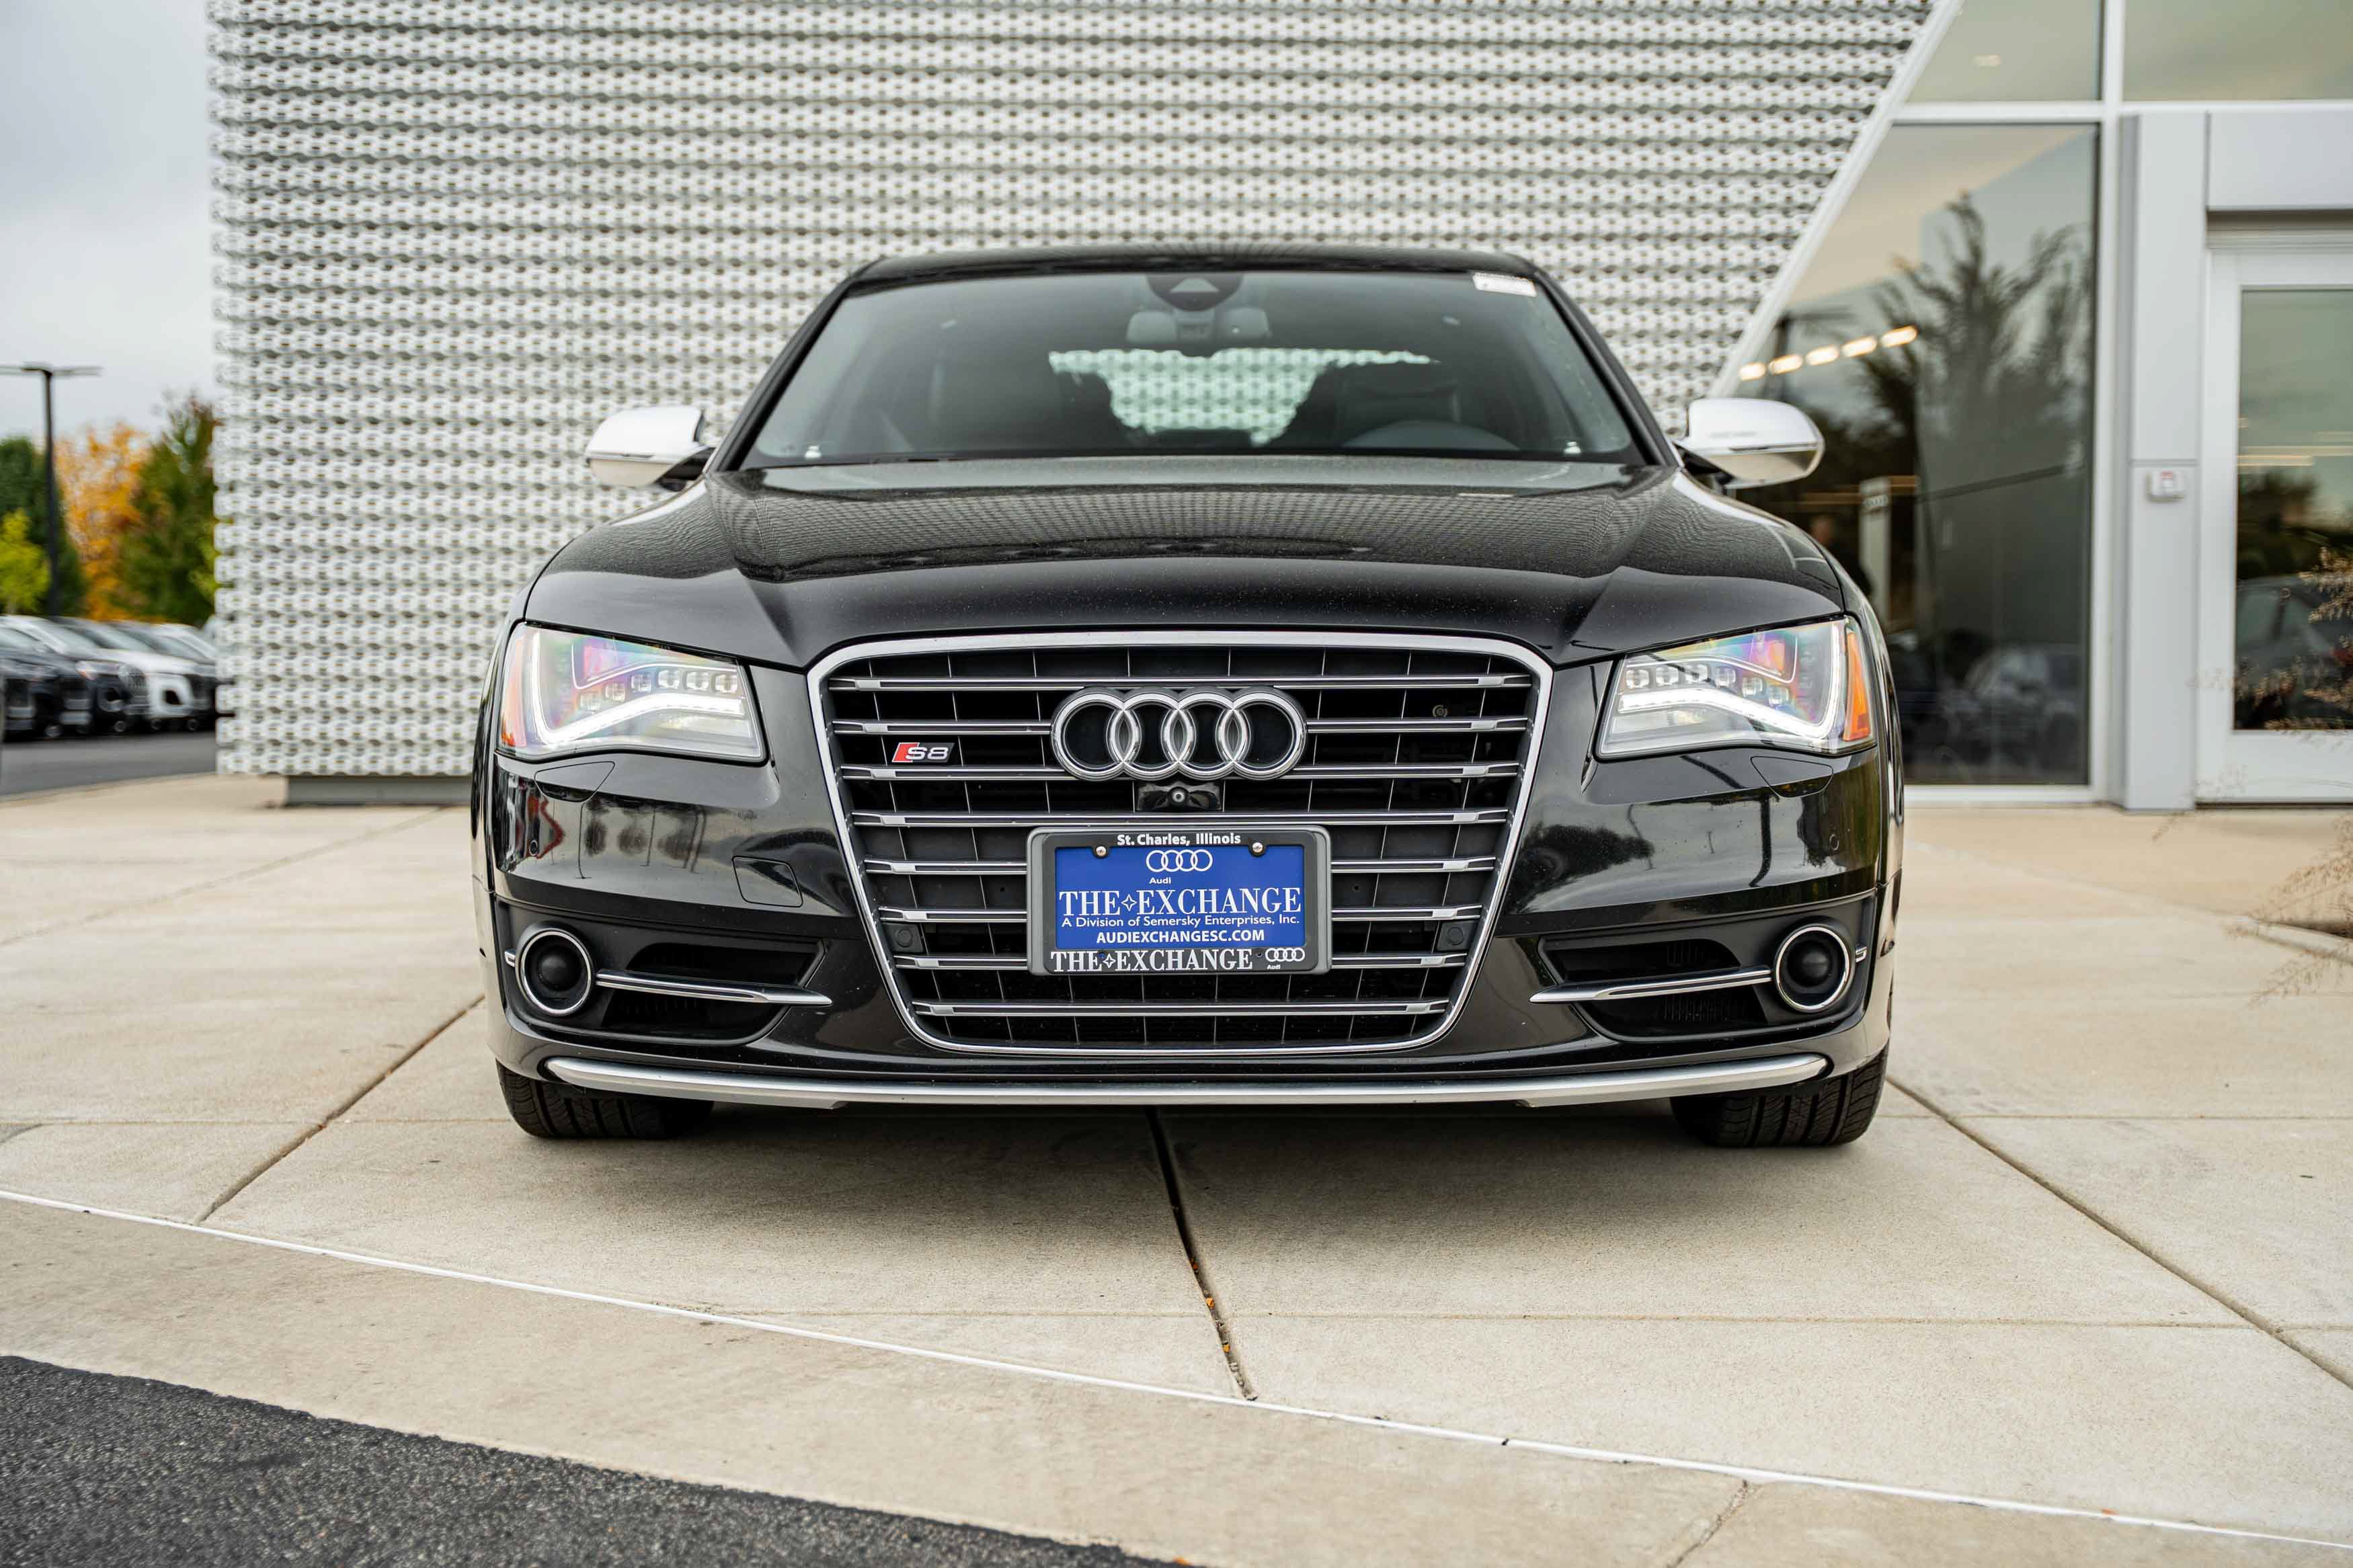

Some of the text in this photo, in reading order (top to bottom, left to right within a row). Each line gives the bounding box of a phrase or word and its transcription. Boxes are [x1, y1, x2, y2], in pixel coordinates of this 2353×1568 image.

[905, 747, 949, 760] S8
[1117, 832, 1241, 846] St. Charles, Illinois
[1059, 887, 1302, 916] THE EXCHANGE
[1061, 914, 1300, 928] A Division of Semersky Enterprises, Inc.
[1096, 930, 1265, 944] AUDIEXCHANGESC.COM
[1050, 948, 1253, 972] THE EXCHANGE
